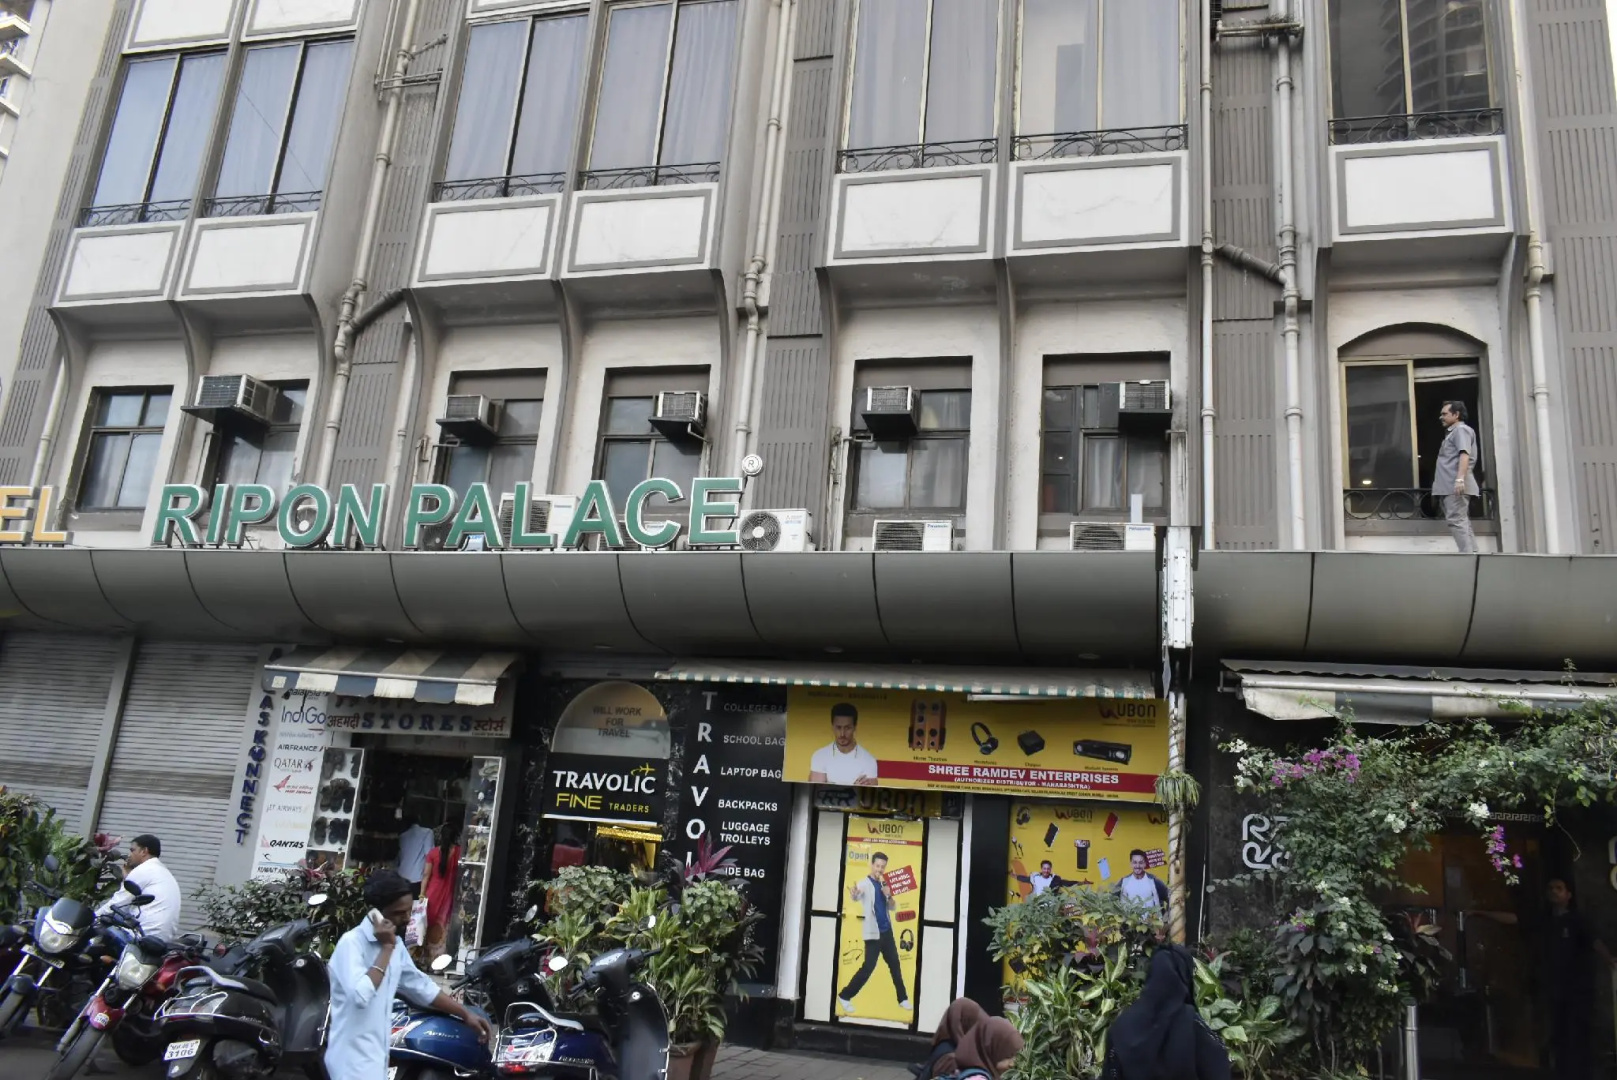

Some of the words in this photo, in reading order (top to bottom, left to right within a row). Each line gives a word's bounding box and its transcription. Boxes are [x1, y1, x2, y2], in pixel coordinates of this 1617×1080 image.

[151, 482, 390, 547] RIPON
[403, 477, 745, 548] PALACE
[592, 706, 613, 716] WILL
[615, 707, 642, 716] WORK
[723, 703, 768, 713] COLLEGE
[1117, 703, 1156, 718] UBON
[281, 705, 326, 725] IndiGo
[362, 711, 473, 732] STORES
[605, 717, 624, 727] FOR
[598, 727, 631, 738] TRAVEL
[723, 734, 762, 746] SCHOOL
[274, 757, 303, 769] QATAR
[720, 767, 759, 778] LAPTOP
[928, 764, 970, 776] SHREE
[973, 767, 1026, 780] RAMDEV
[1030, 767, 1119, 784] ENTERPRISES
[552, 770, 657, 794] TRAVOLIC
[556, 793, 603, 810] FINE
[609, 802, 650, 813] TRADERS
[718, 799, 778, 812] BACKPACKS
[1067, 809, 1093, 819] UBON
[722, 821, 770, 833] LUGGAGE
[879, 824, 904, 834] UBON
[270, 839, 304, 849] QANTAS
[719, 833, 771, 846] TROLLEYS
[848, 849, 869, 862] Open
[744, 867, 766, 878] BAG
